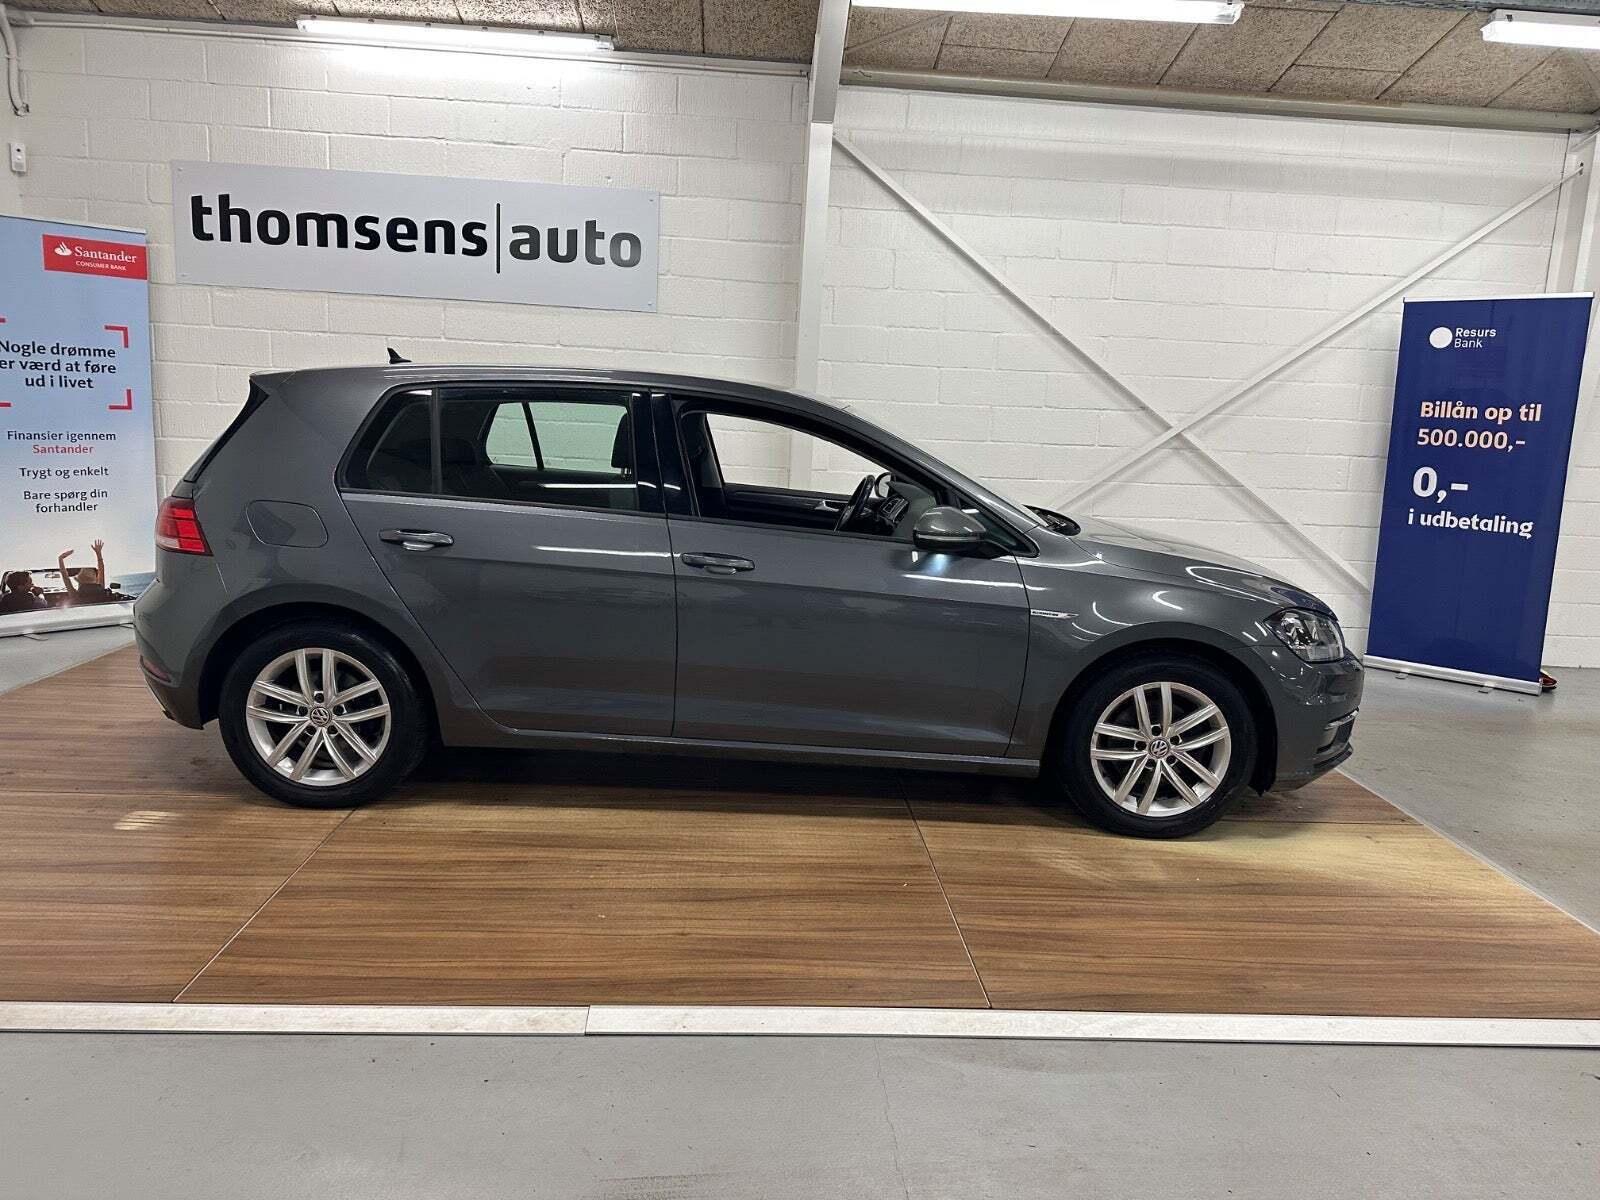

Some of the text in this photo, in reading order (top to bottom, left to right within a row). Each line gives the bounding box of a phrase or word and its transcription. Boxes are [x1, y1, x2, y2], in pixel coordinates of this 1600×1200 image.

[191, 194, 642, 268] thomsens auto
[74, 245, 136, 263] Santander
[76, 260, 109, 269] CONSUMER
[1455, 327, 1497, 338] Resurs
[0, 340, 116, 358] Nogle drømme
[1454, 337, 1483, 348] Bank
[0, 360, 117, 373] er værd at føre
[25, 375, 95, 389] ud i livet
[1420, 401, 1543, 425] Billån op til
[7, 430, 117, 443] Finansier igennem
[1417, 428, 1526, 451] 500.000,-
[32, 444, 94, 454] Santander
[20, 466, 109, 479] Trygt og enkelt
[1412, 466, 1469, 503] 0,-
[23, 488, 108, 501] Bare spørg din
[36, 502, 98, 513] forhandler
[1408, 508, 1533, 539] i udbetaling
